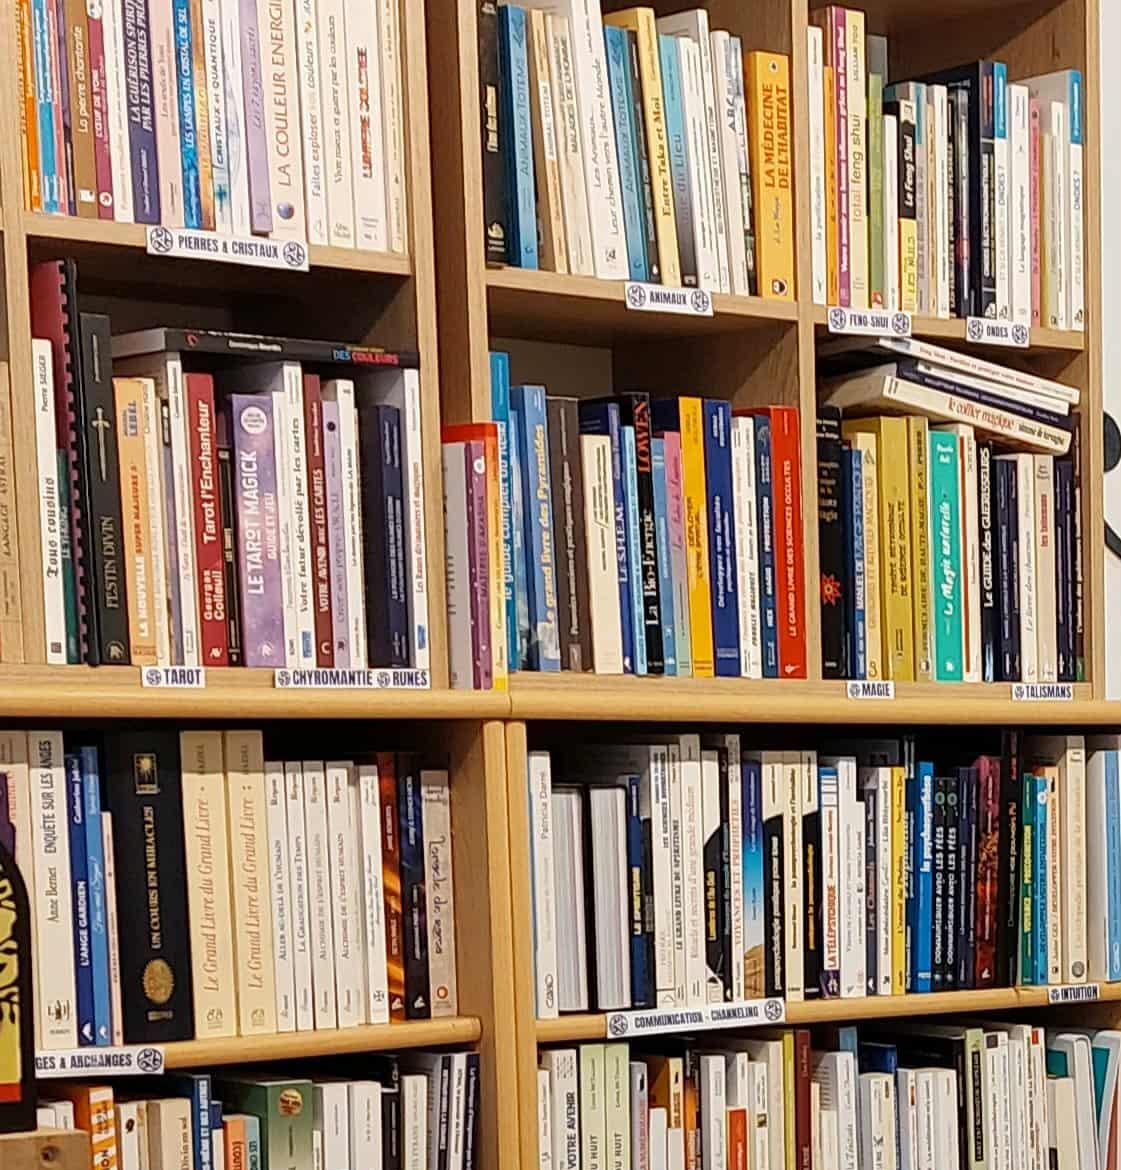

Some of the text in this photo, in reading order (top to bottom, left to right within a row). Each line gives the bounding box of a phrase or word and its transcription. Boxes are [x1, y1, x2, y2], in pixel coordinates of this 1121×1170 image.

[651, 96, 671, 217] Entre Taka et Moi
[760, 82, 775, 188] LA MÉDECINE
[775, 85, 789, 189] DE L'HABITAT
[848, 114, 864, 222] total feng shui
[903, 134, 915, 207] Le Feng Shui
[178, 235, 220, 252] PIERRES
[232, 240, 278, 258] CRISTAUX
[649, 291, 687, 305] ANIMAUX
[986, 319, 1009, 338] ONDES
[634, 400, 651, 473] LOWEN
[197, 400, 217, 544] Tarot l'Enchanteur
[240, 450, 265, 594] LE TAROT MAGICK
[534, 424, 556, 627] Le grand livre des Pyramides
[100, 516, 118, 608] FESTIN DIVIN
[202, 569, 213, 620] Georges
[211, 570, 224, 620] Colleuil
[164, 669, 201, 684] TAROT
[292, 669, 373, 686] CHYROMANTIE
[392, 670, 427, 686] RUNES
[861, 683, 890, 697] MAGIE
[1025, 685, 1072, 700] TALISMANS
[39, 741, 60, 923] Anne Bernet ENQUÊTE SUR LES ANGES
[144, 805, 161, 949] UN COURS EN MIRACLES
[195, 799, 220, 991] Le Grand Livre du Grand Livre
[240, 798, 264, 988] Le Grand Livre du Grand Livre
[77, 880, 90, 966] L'ANGE GARDIEN
[634, 1006, 759, 1029] COMMUNICATION CHANNELING
[1061, 985, 1098, 1001] INTUITION
[566, 1092, 576, 1130] AVENIR
[567, 1133, 577, 1169] VOTRE
[589, 1134, 598, 1159] HUIT
[613, 1132, 622, 1157] HUIT
